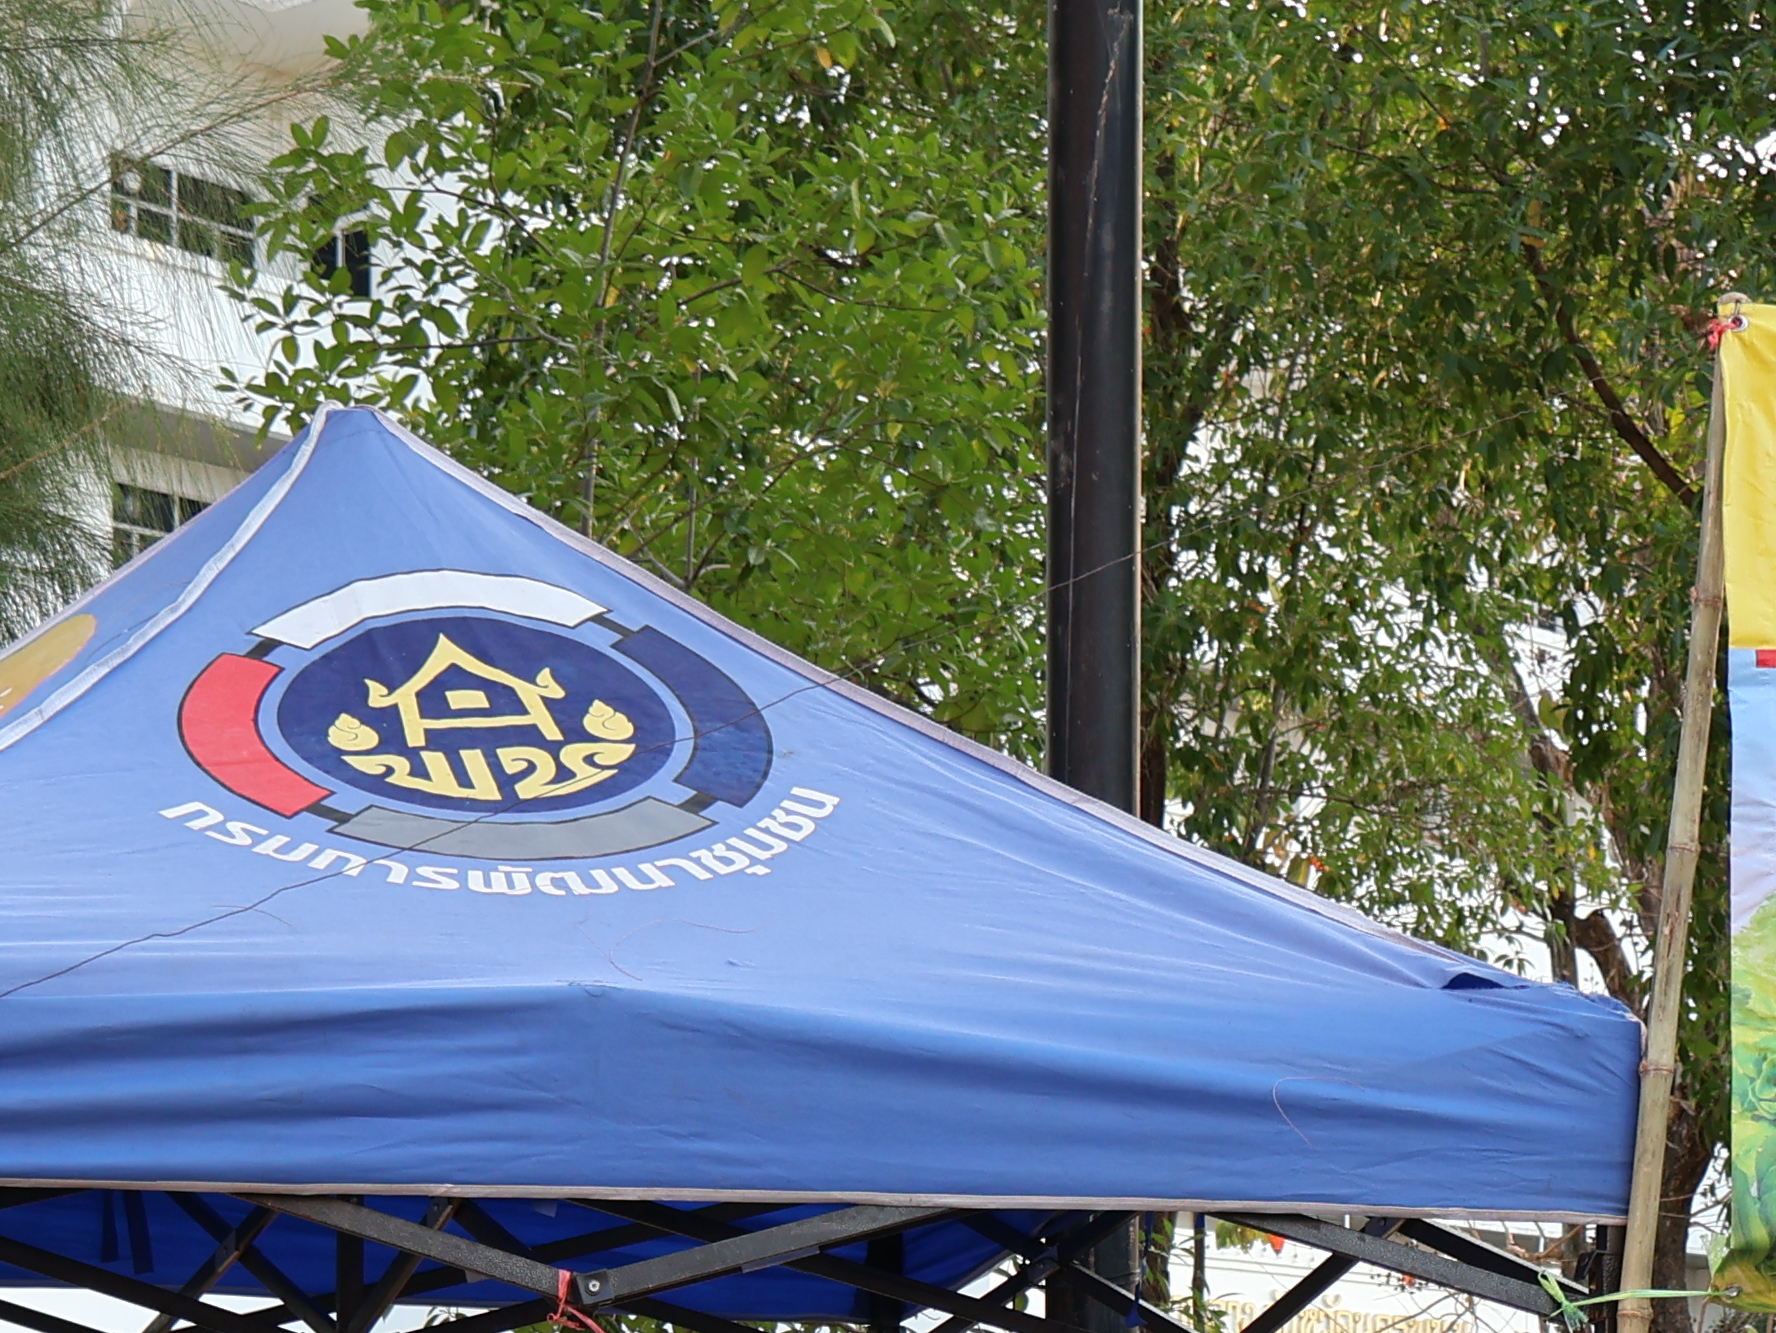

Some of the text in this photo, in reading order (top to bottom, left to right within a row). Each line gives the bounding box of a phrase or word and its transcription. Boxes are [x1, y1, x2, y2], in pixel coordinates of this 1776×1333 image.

[159, 786, 842, 896] กรมการพัฒนาชุมชน
